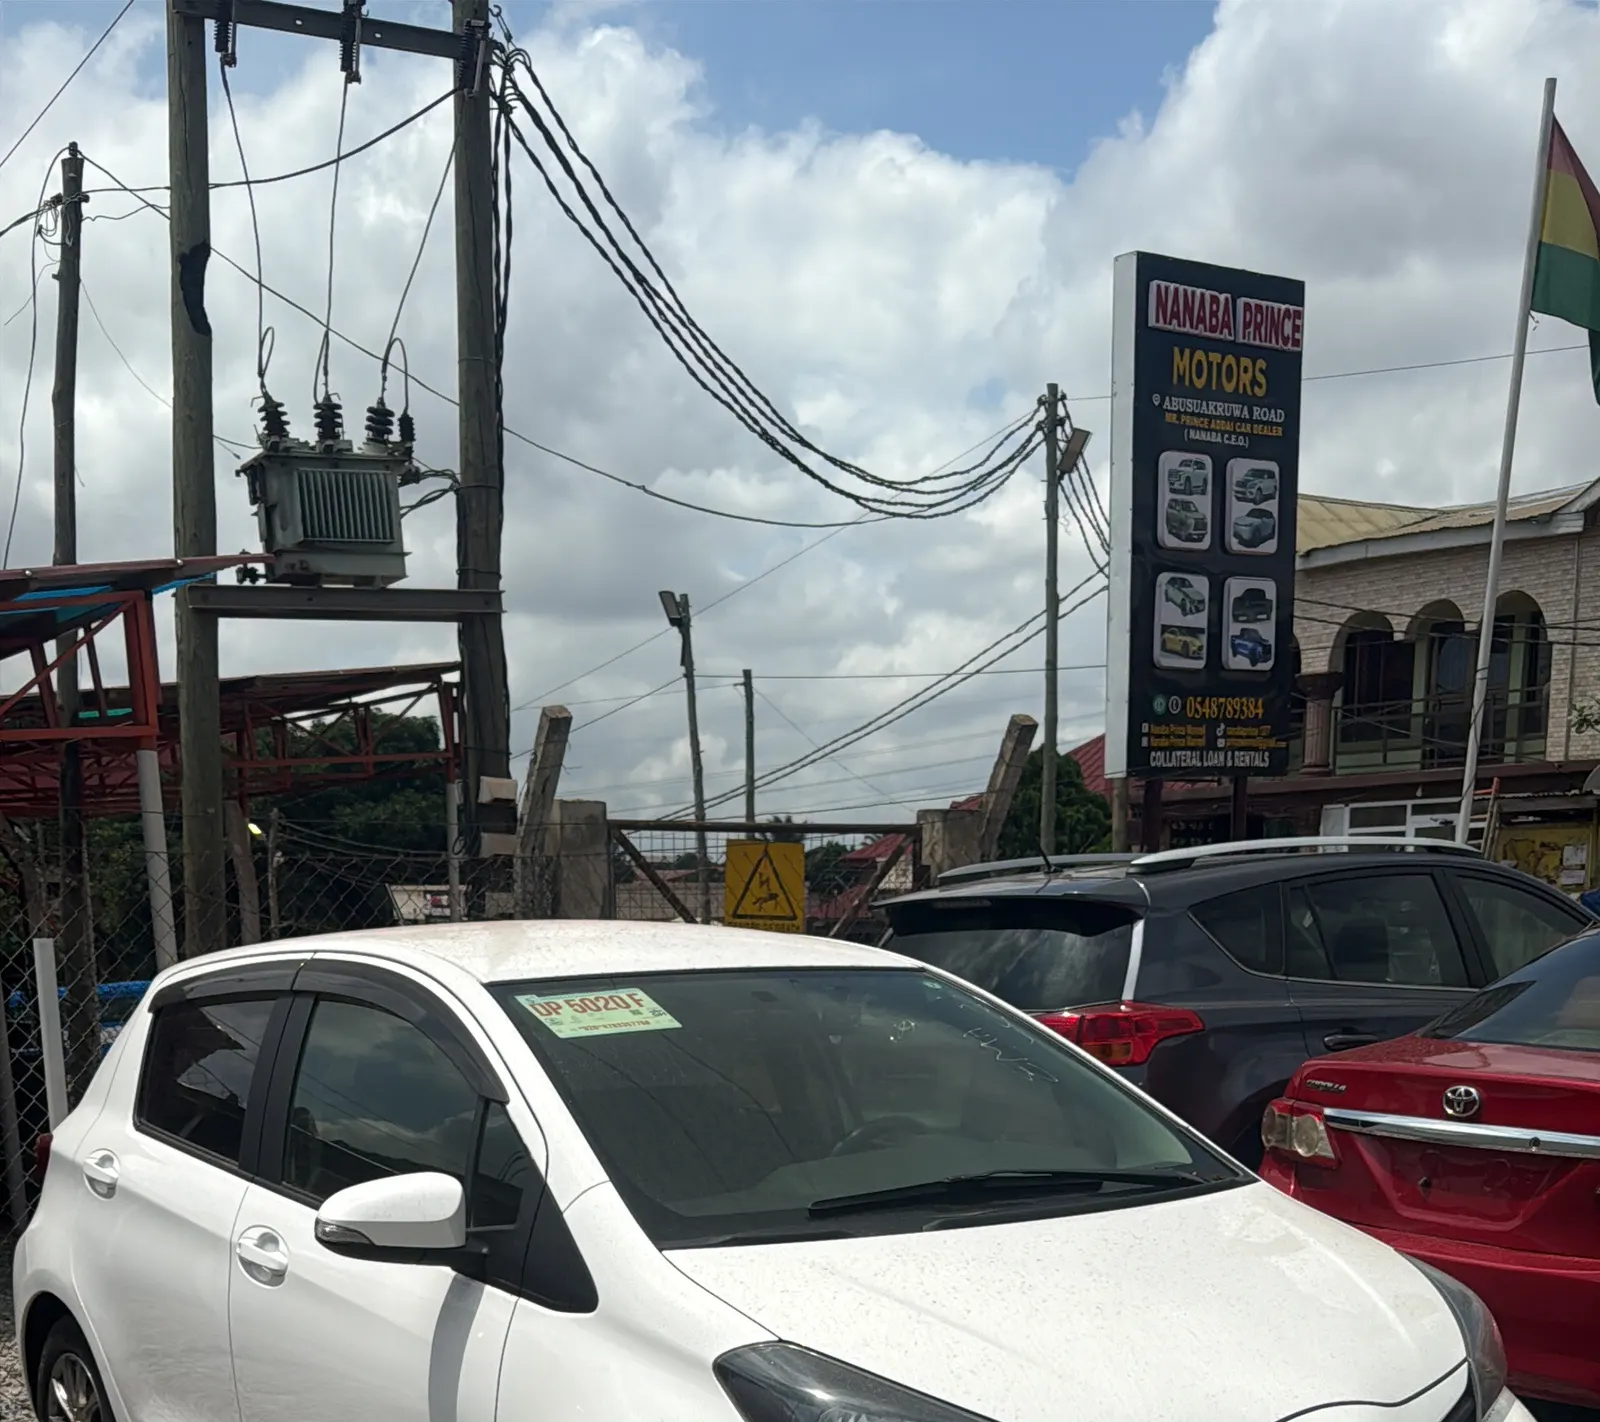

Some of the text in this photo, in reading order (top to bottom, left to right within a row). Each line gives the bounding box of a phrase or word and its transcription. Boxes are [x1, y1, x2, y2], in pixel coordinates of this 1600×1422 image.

[1154, 283, 1302, 349] NANABA PRINCE
[1172, 347, 1267, 397] MOTORS
[1163, 396, 1285, 423] ABUSUAKRUWA ROAD
[1180, 414, 1209, 429] PRINCE
[1235, 423, 1252, 434] CAR
[1252, 425, 1283, 437] DEALER
[1188, 429, 1222, 443] NANABA
[1186, 696, 1264, 719] 0548789384
[1150, 750, 1202, 768] COLLATERAL
[1203, 750, 1225, 768] LOAN
[1234, 750, 1270, 768] RENTALS
[565, 996, 630, 1014] 5020
[626, 993, 645, 1008] F
